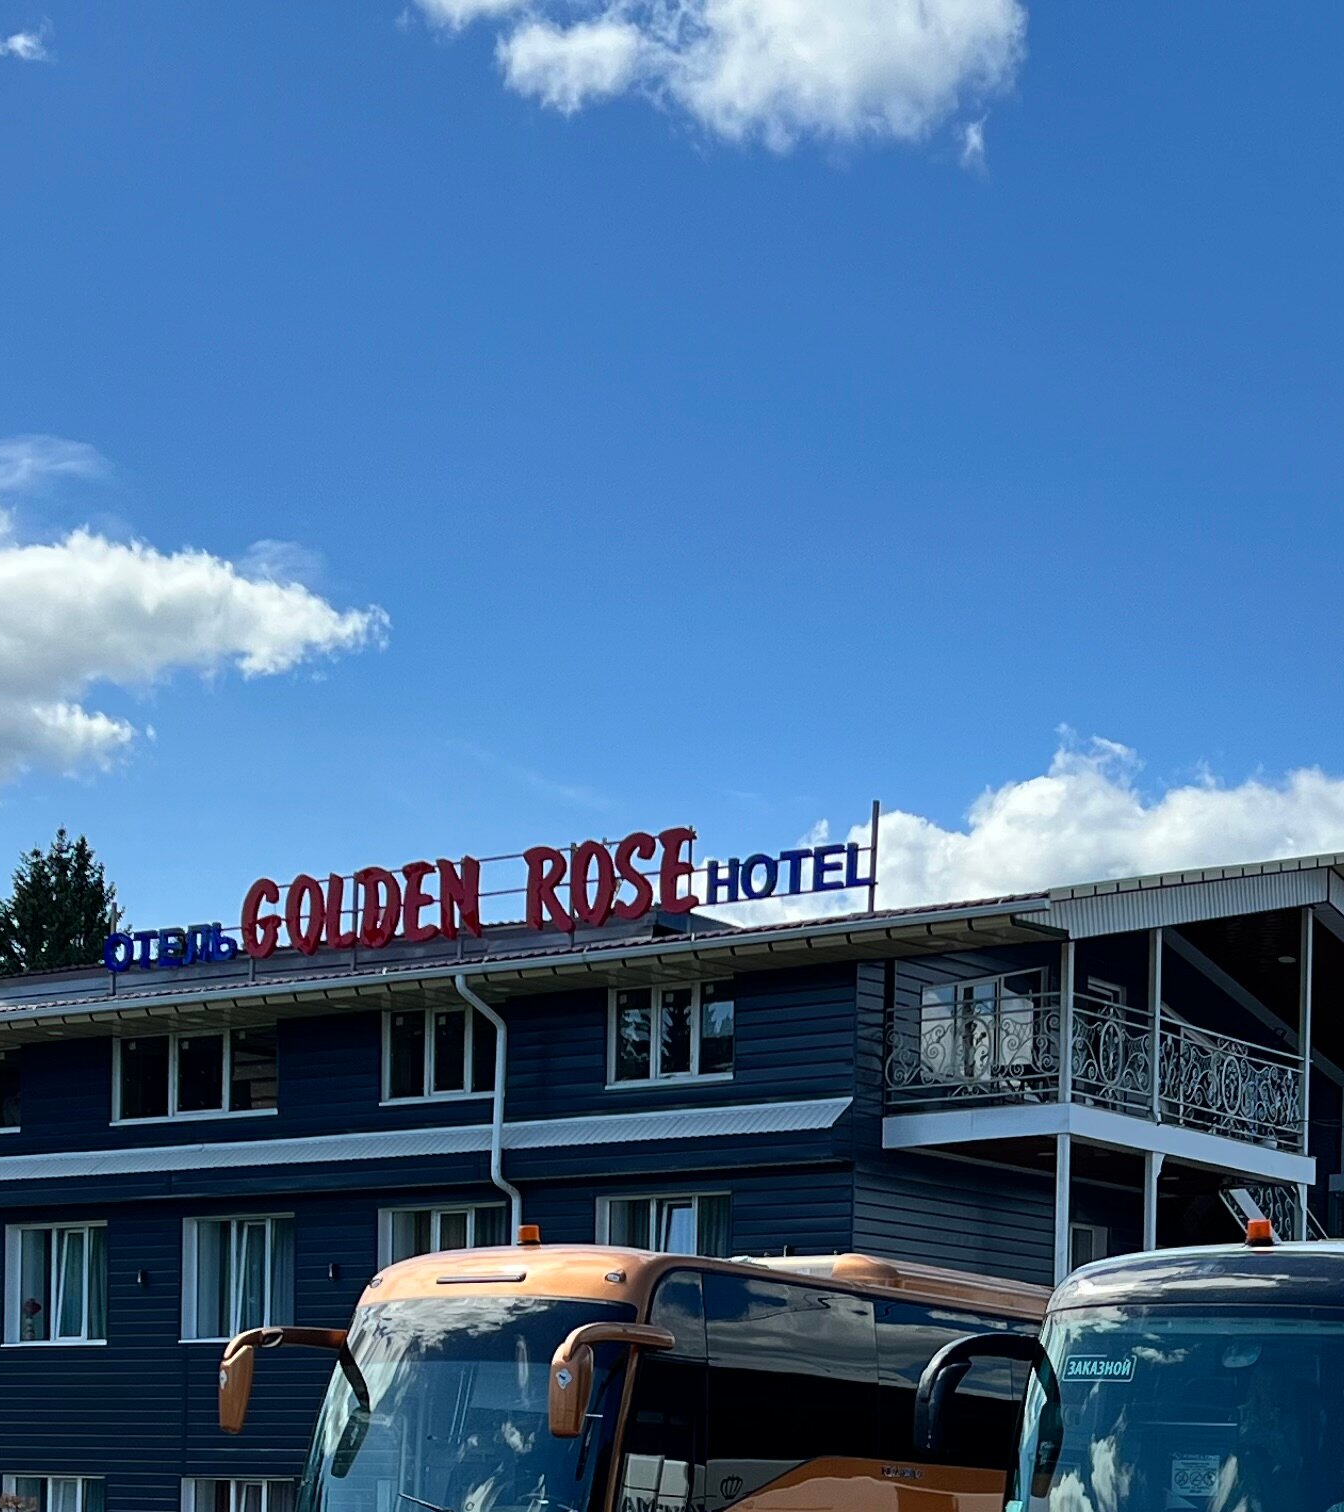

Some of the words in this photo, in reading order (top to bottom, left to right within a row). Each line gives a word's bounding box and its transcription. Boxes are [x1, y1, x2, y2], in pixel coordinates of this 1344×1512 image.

[241, 856, 482, 959] GOLDEN
[523, 827, 700, 933] ROSE
[707, 842, 875, 904] HOTEL
[106, 922, 238, 972] ОТЕЛЬ
[1067, 1358, 1132, 1376] ЗАКАЗНОЙ
